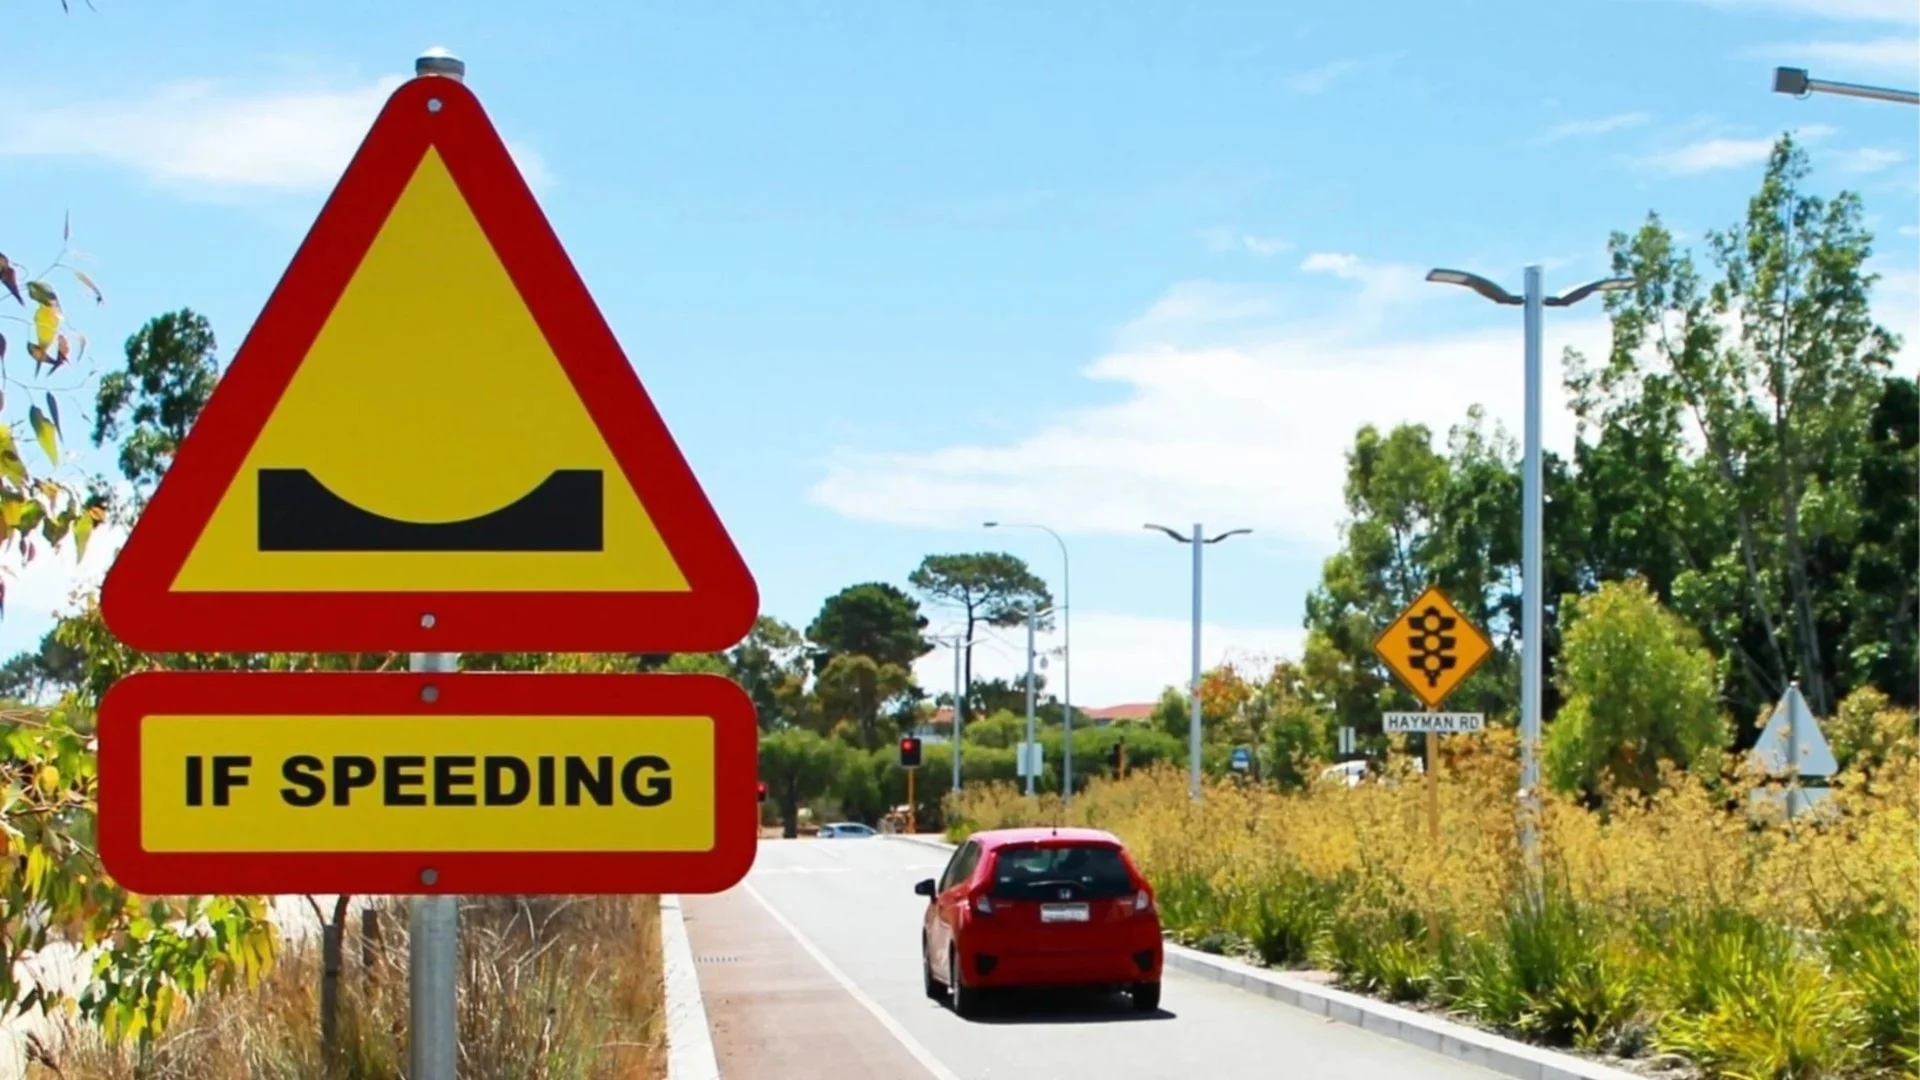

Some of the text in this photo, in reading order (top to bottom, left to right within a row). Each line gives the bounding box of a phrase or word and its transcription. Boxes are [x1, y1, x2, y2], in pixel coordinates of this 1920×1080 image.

[1388, 715, 1479, 729] HAYMAN RD
[184, 755, 673, 807] IF SPEEDING
